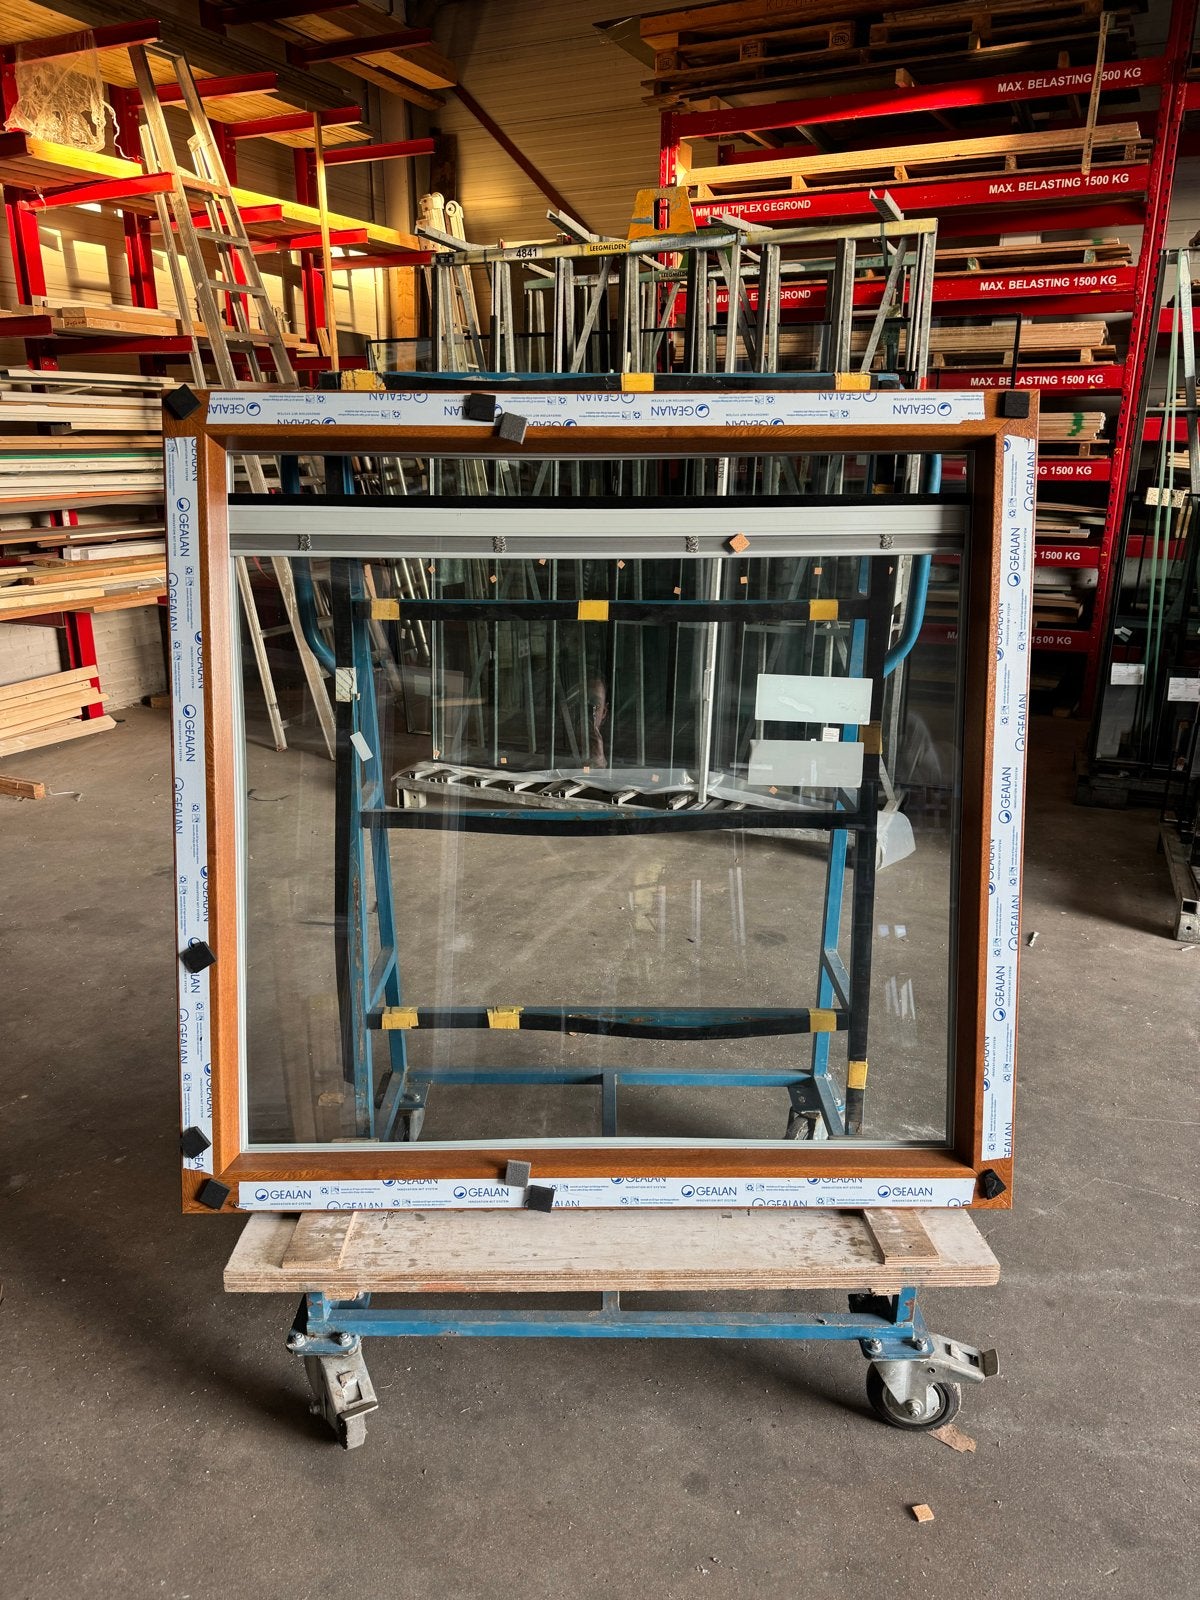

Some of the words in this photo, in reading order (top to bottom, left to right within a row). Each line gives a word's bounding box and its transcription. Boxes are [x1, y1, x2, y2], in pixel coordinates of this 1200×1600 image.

[997, 81, 1024, 93] MAX.
[1027, 73, 1092, 90] BELASTING
[1100, 69, 1121, 81] 500
[1123, 67, 1142, 79] KG
[988, 182, 1015, 195] MAX.
[1018, 177, 1081, 192] BELASTING
[1084, 175, 1109, 186] 1500
[1111, 173, 1130, 184] KG
[695, 207, 710, 217] MM
[712, 204, 762, 216] MULTIPLEX
[762, 199, 812, 212] GEGROND
[589, 243, 627, 252] LEEGMELDEN
[516, 248, 537, 258] 4841
[980, 281, 1006, 291] MAX.
[1008, 277, 1070, 290] BELASTING
[1073, 276, 1097, 287] 1500
[1100, 275, 1117, 285] KG
[779, 290, 811, 300] GROND
[970, 377, 996, 386] MAX.
[1061, 374, 1085, 384] 1500
[1087, 374, 1104, 384] KG
[207, 404, 245, 414] GEALA
[651, 405, 694, 416] GEALAN
[892, 404, 936, 414] GEALAN
[1050, 466, 1073, 475] 1500
[1076, 466, 1092, 475] KG
[179, 513, 190, 557] GEALAN
[1010, 527, 1020, 571] GEALAN
[1041, 551, 1063, 561] 1500
[1065, 552, 1081, 561] KG
[1031, 635, 1054, 644] 1500
[1056, 636, 1072, 645] KG
[184, 720, 195, 762] GEALAN
[1000, 767, 1011, 808] GEALAN
[995, 966, 1005, 1007] GEALAN
[270, 1190, 311, 1199] GEALAN
[468, 1187, 509, 1197] GEALAN
[696, 1186, 737, 1196] GEALAN
[892, 1187, 933, 1196] GEALAN
